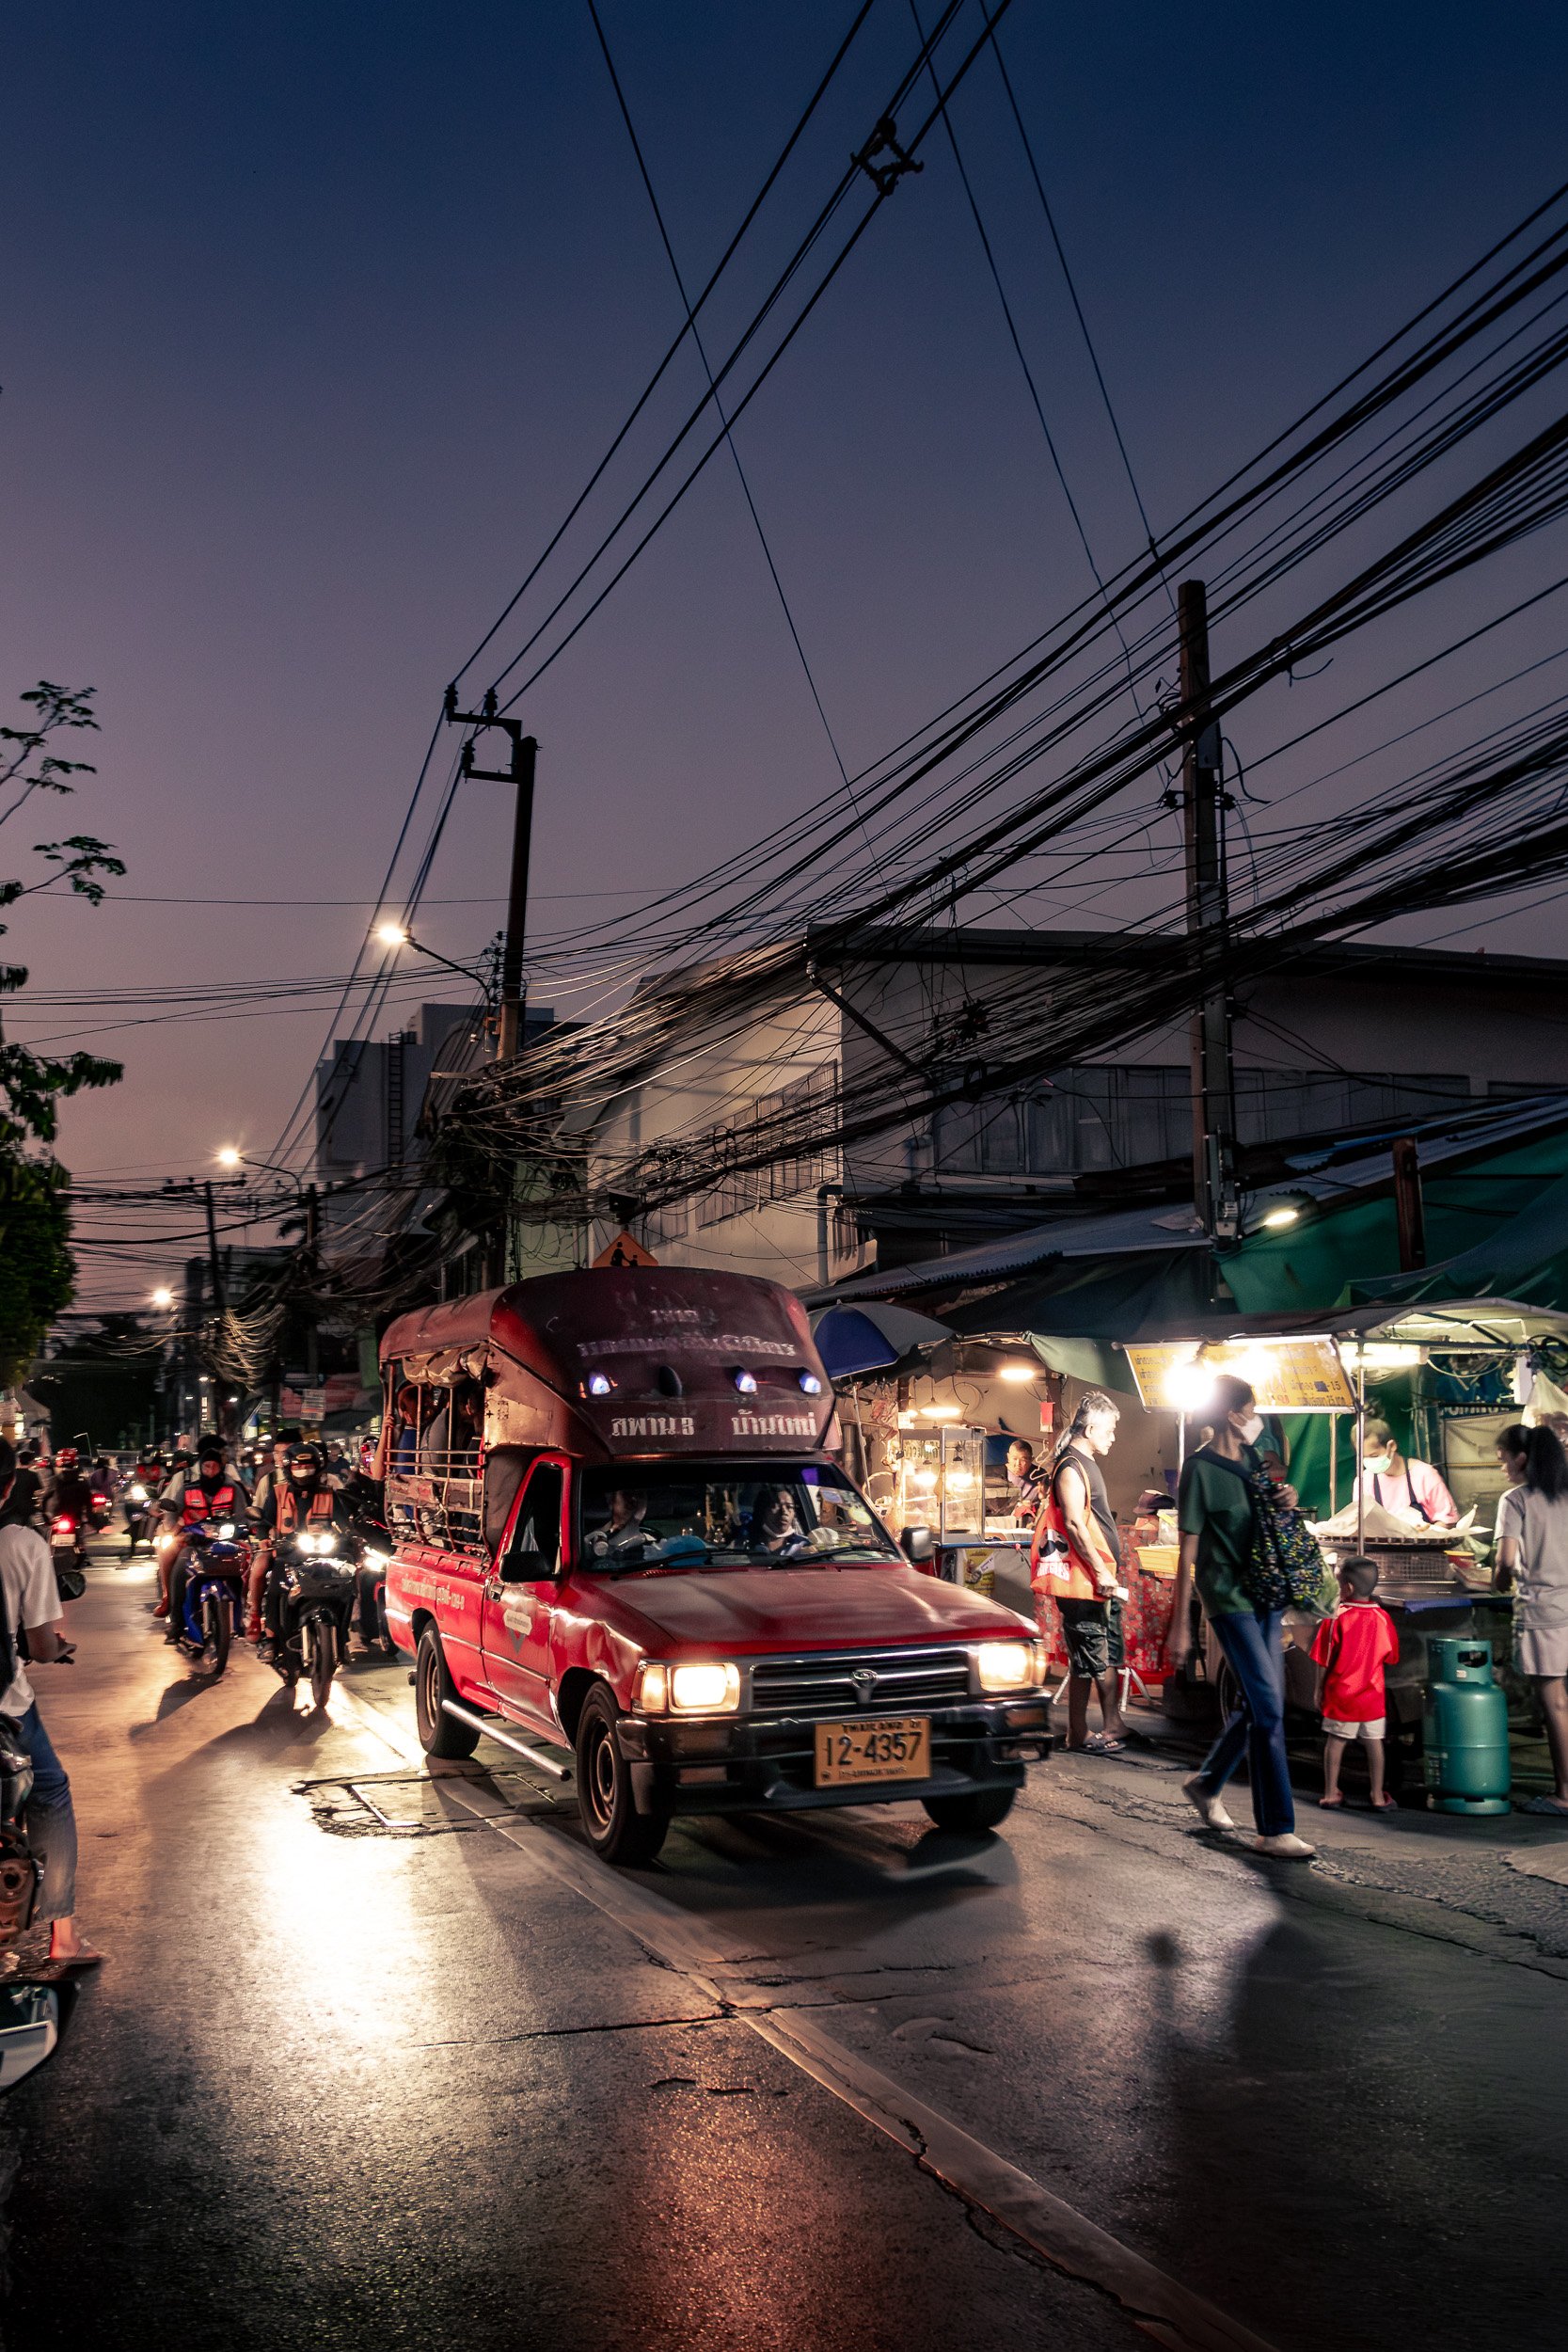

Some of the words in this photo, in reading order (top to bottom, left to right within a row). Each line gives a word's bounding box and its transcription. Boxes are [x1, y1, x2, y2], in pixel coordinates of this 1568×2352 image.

[731, 1408, 817, 1436] บ้านใหม่
[826, 1731, 923, 1766] 12-4357
